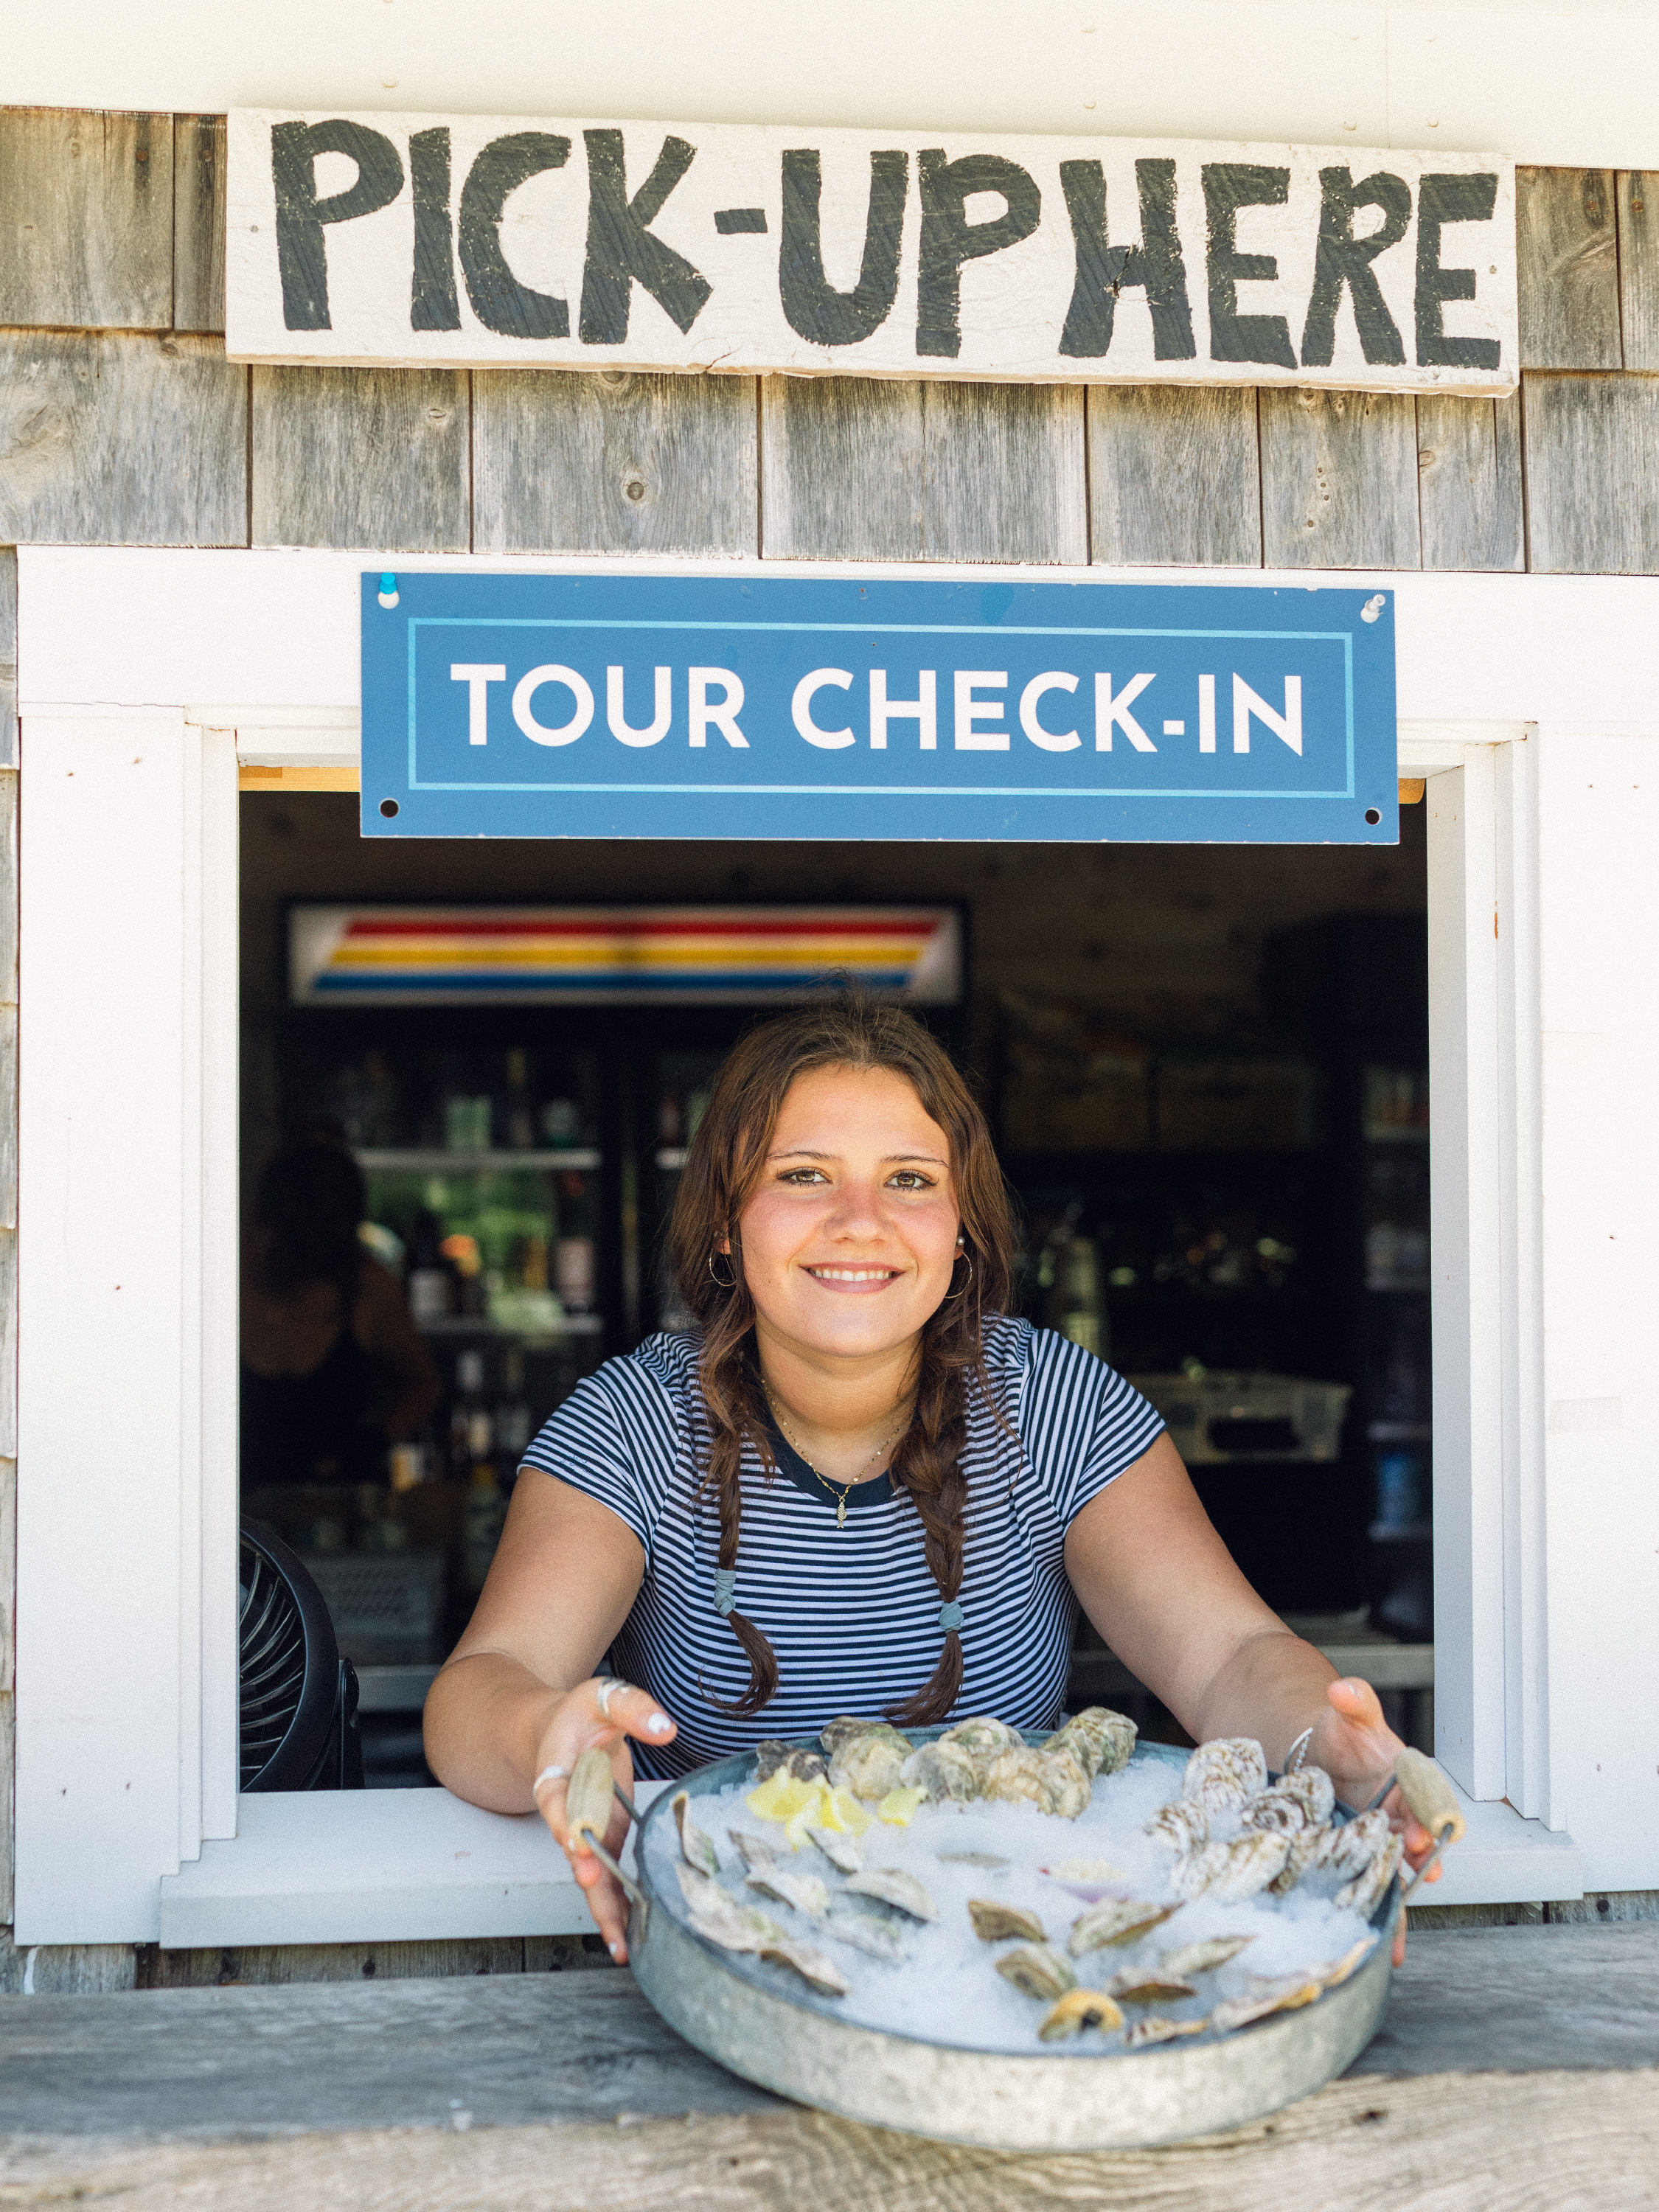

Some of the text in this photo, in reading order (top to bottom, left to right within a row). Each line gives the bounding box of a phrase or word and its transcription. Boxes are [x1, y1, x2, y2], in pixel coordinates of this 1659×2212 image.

[272, 120, 1500, 369] PICK-UP HERE
[451, 664, 1302, 756] TOUR CHECK-IN
